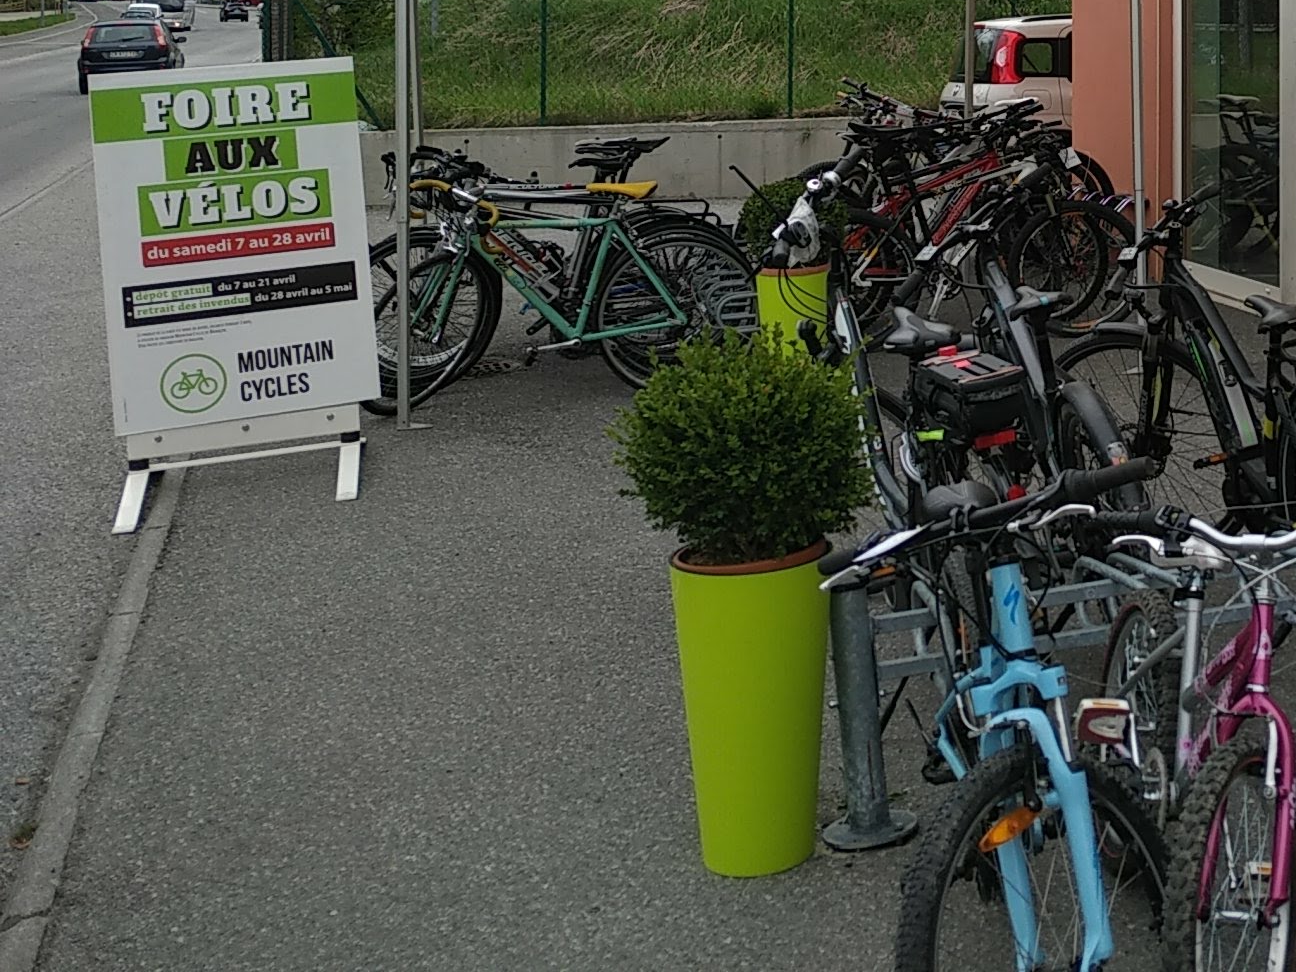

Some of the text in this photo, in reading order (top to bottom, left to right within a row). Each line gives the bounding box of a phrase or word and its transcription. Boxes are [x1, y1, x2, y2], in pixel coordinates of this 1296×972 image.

[140, 81, 312, 134] FOIRE
[185, 135, 281, 176] AUX
[148, 177, 320, 228] VÉLOS
[147, 228, 330, 260] du samedi 7 au 28 avril
[136, 282, 353, 317] retrait des invendus du 28 avril au 5 mai
[170, 285, 211, 302] gratuit
[217, 281, 232, 292] du
[234, 280, 240, 290] 7
[243, 279, 256, 289] au
[257, 278, 271, 287] 21
[272, 274, 296, 286] avril
[237, 339, 334, 374] MOUNTAIN
[240, 372, 310, 403] CYCLES
